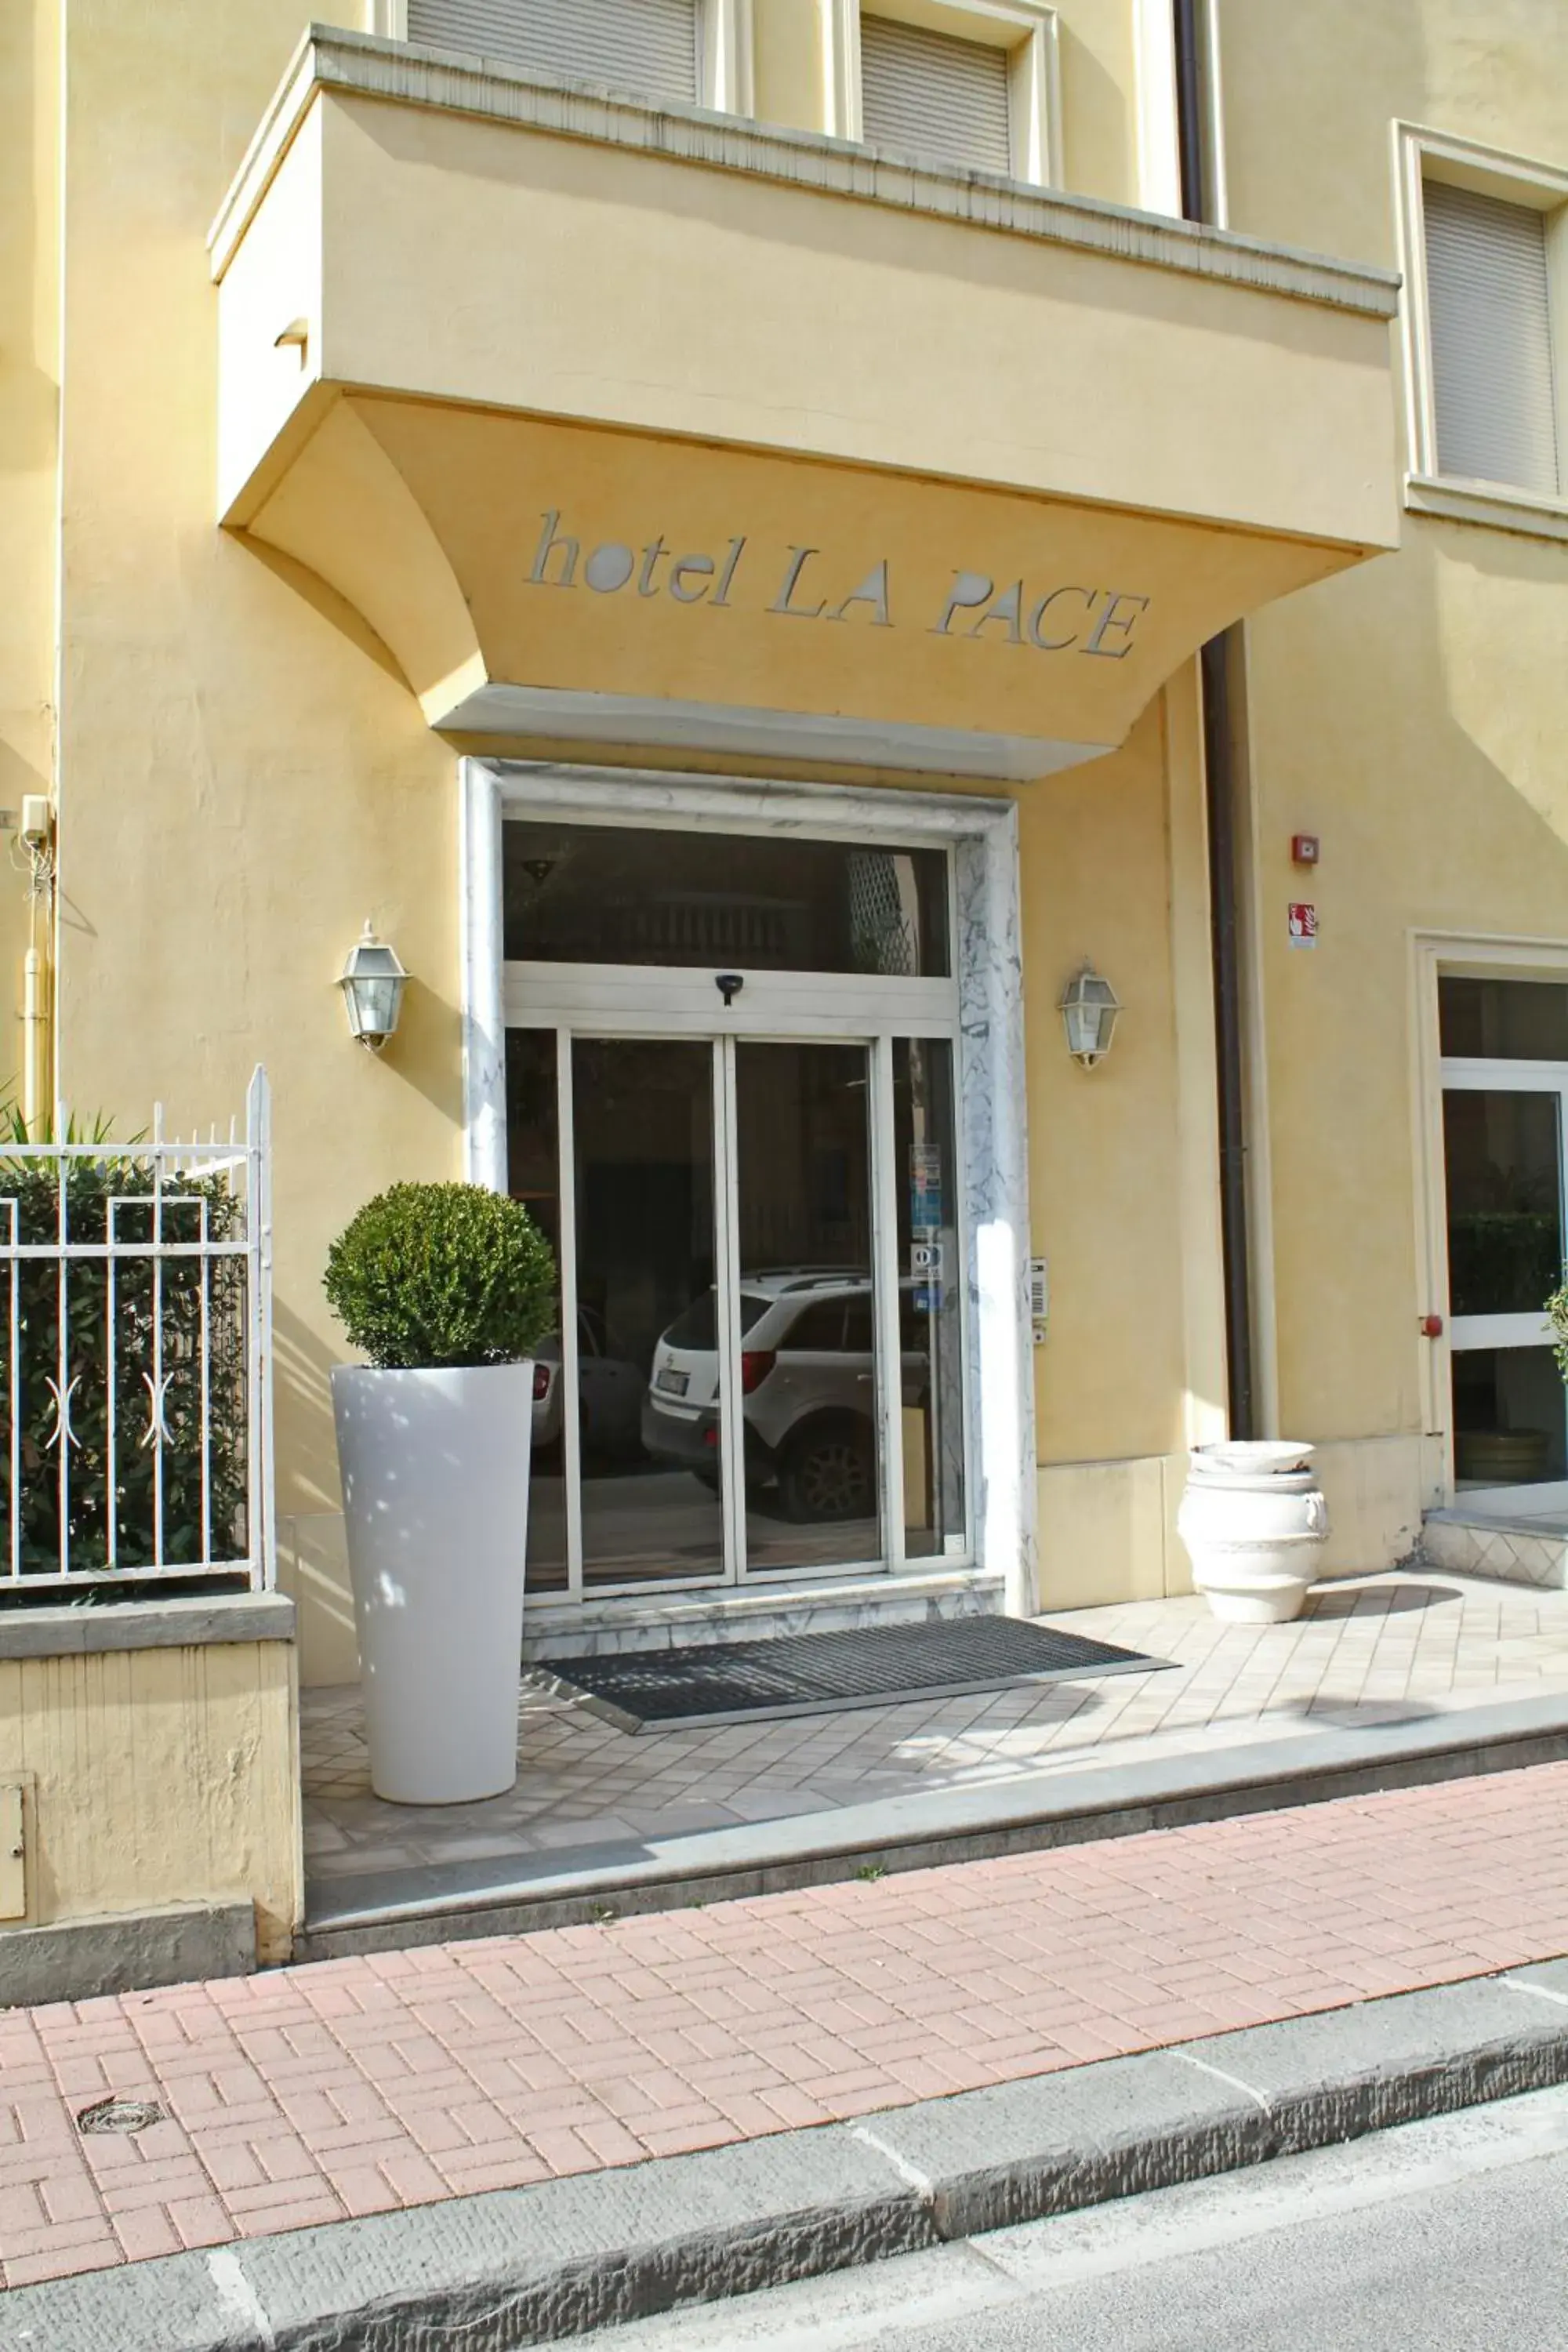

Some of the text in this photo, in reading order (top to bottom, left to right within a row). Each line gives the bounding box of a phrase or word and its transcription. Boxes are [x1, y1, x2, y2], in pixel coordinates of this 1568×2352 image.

[522, 507, 1150, 659] hotel LA PACE
